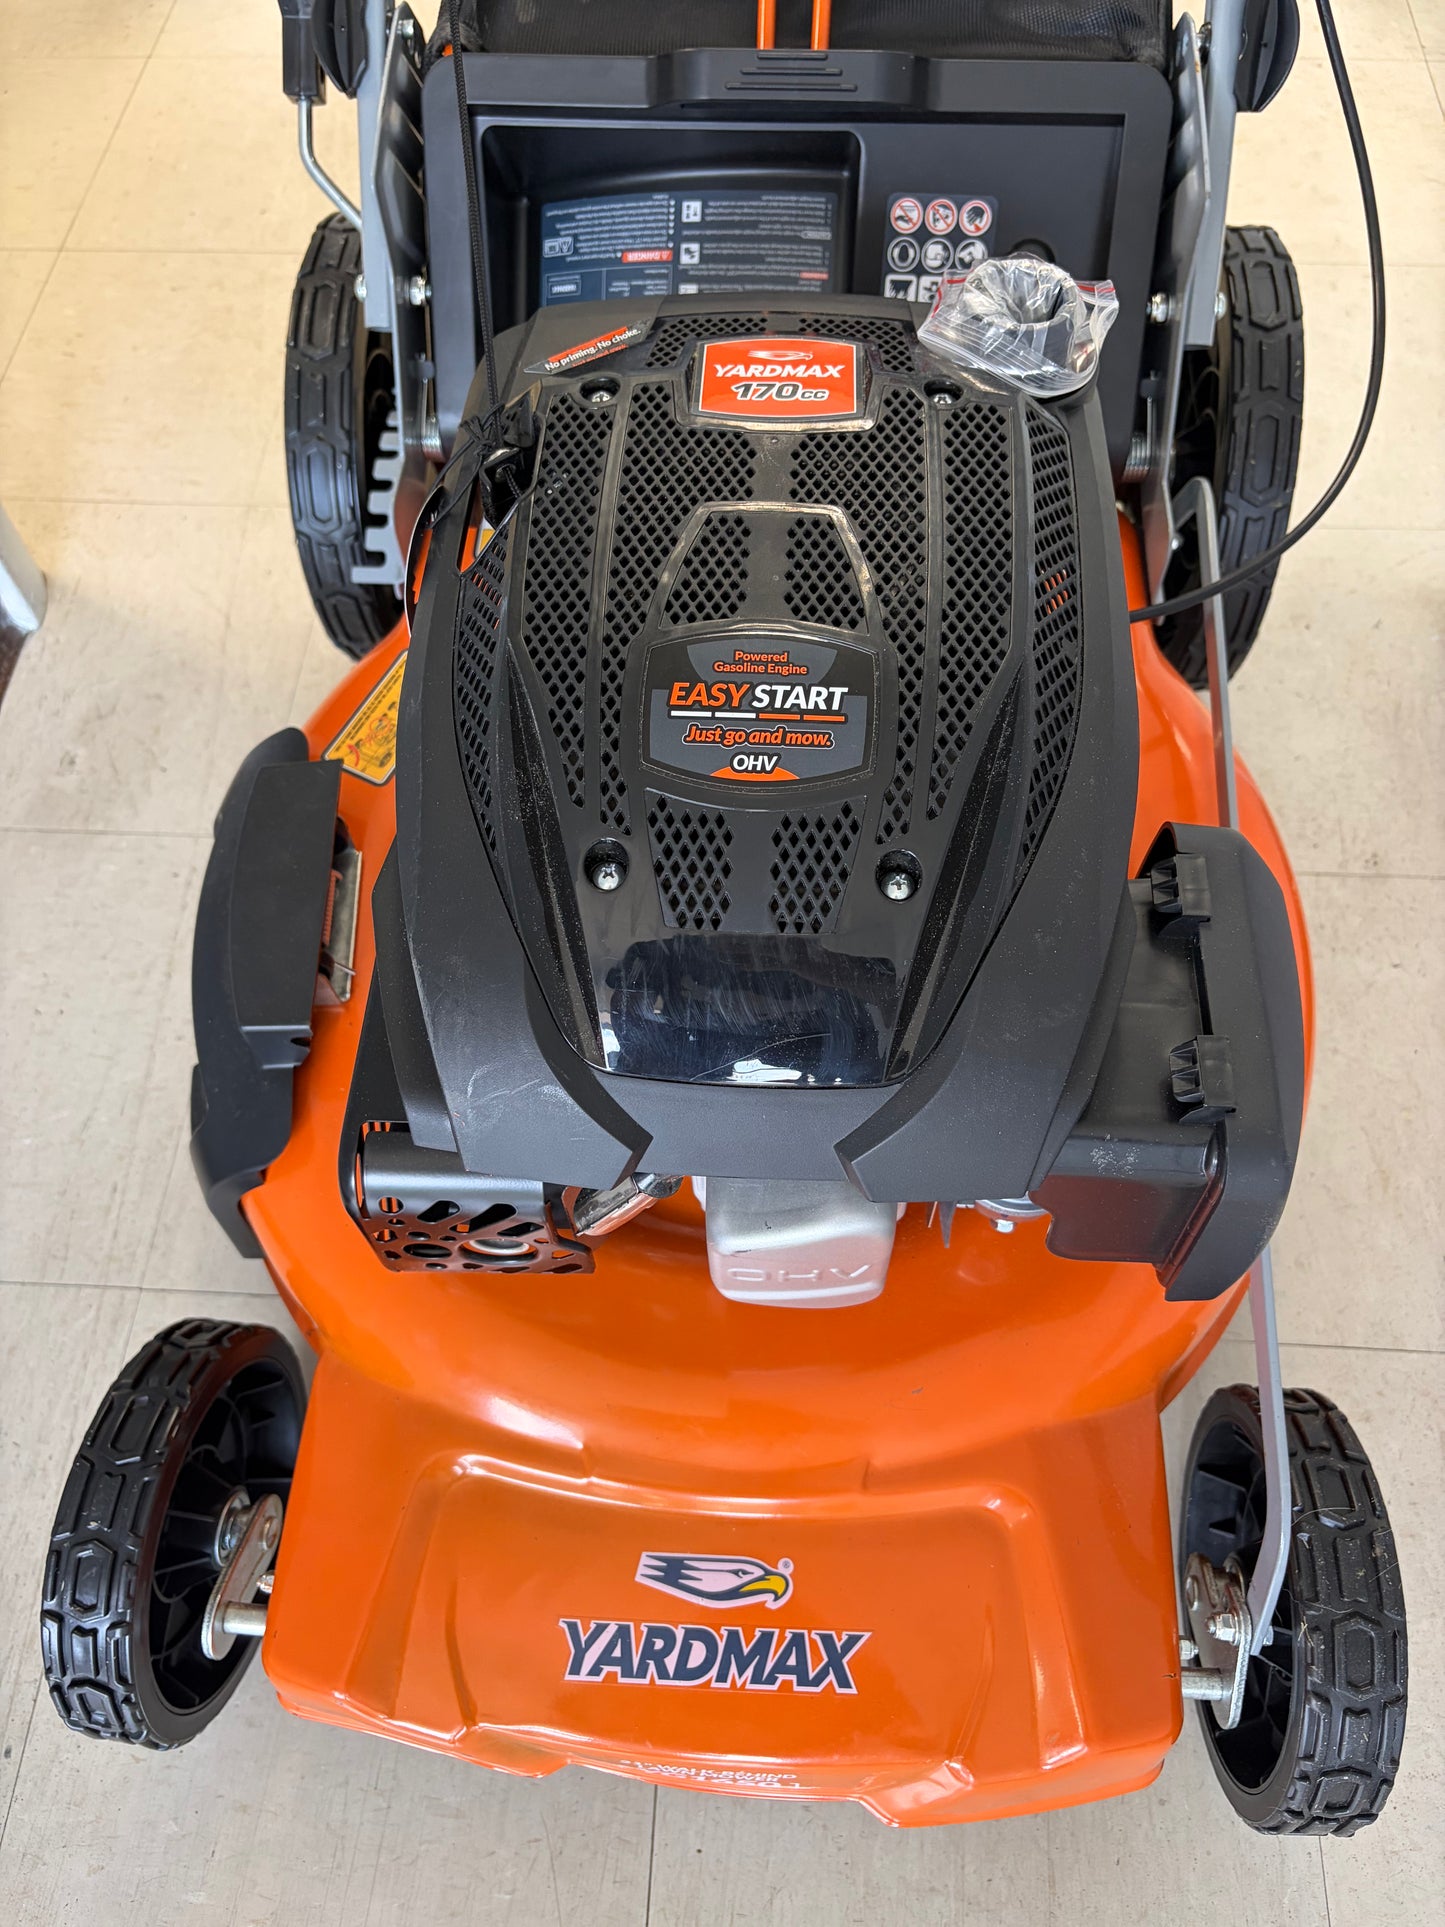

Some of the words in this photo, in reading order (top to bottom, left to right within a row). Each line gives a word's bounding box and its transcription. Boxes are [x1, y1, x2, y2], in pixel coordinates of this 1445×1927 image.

[544, 361, 560, 371] No
[560, 346, 598, 367] priming.
[597, 339, 611, 350] No
[612, 328, 641, 344] choke.
[714, 364, 846, 378] YARDMAX
[731, 381, 829, 401] 170cc
[735, 651, 788, 662] Powered
[714, 661, 765, 673] Gasoline
[768, 664, 808, 676] Engine
[669, 682, 750, 707] EASY
[752, 684, 849, 710] START
[686, 726, 722, 742] Just
[723, 730, 746, 745] go
[749, 729, 783, 744] and
[785, 734, 831, 746] mow.
[733, 754, 778, 771] OHV
[727, 1264, 872, 1282] OHV
[558, 1618, 873, 1695] YARDMAX
